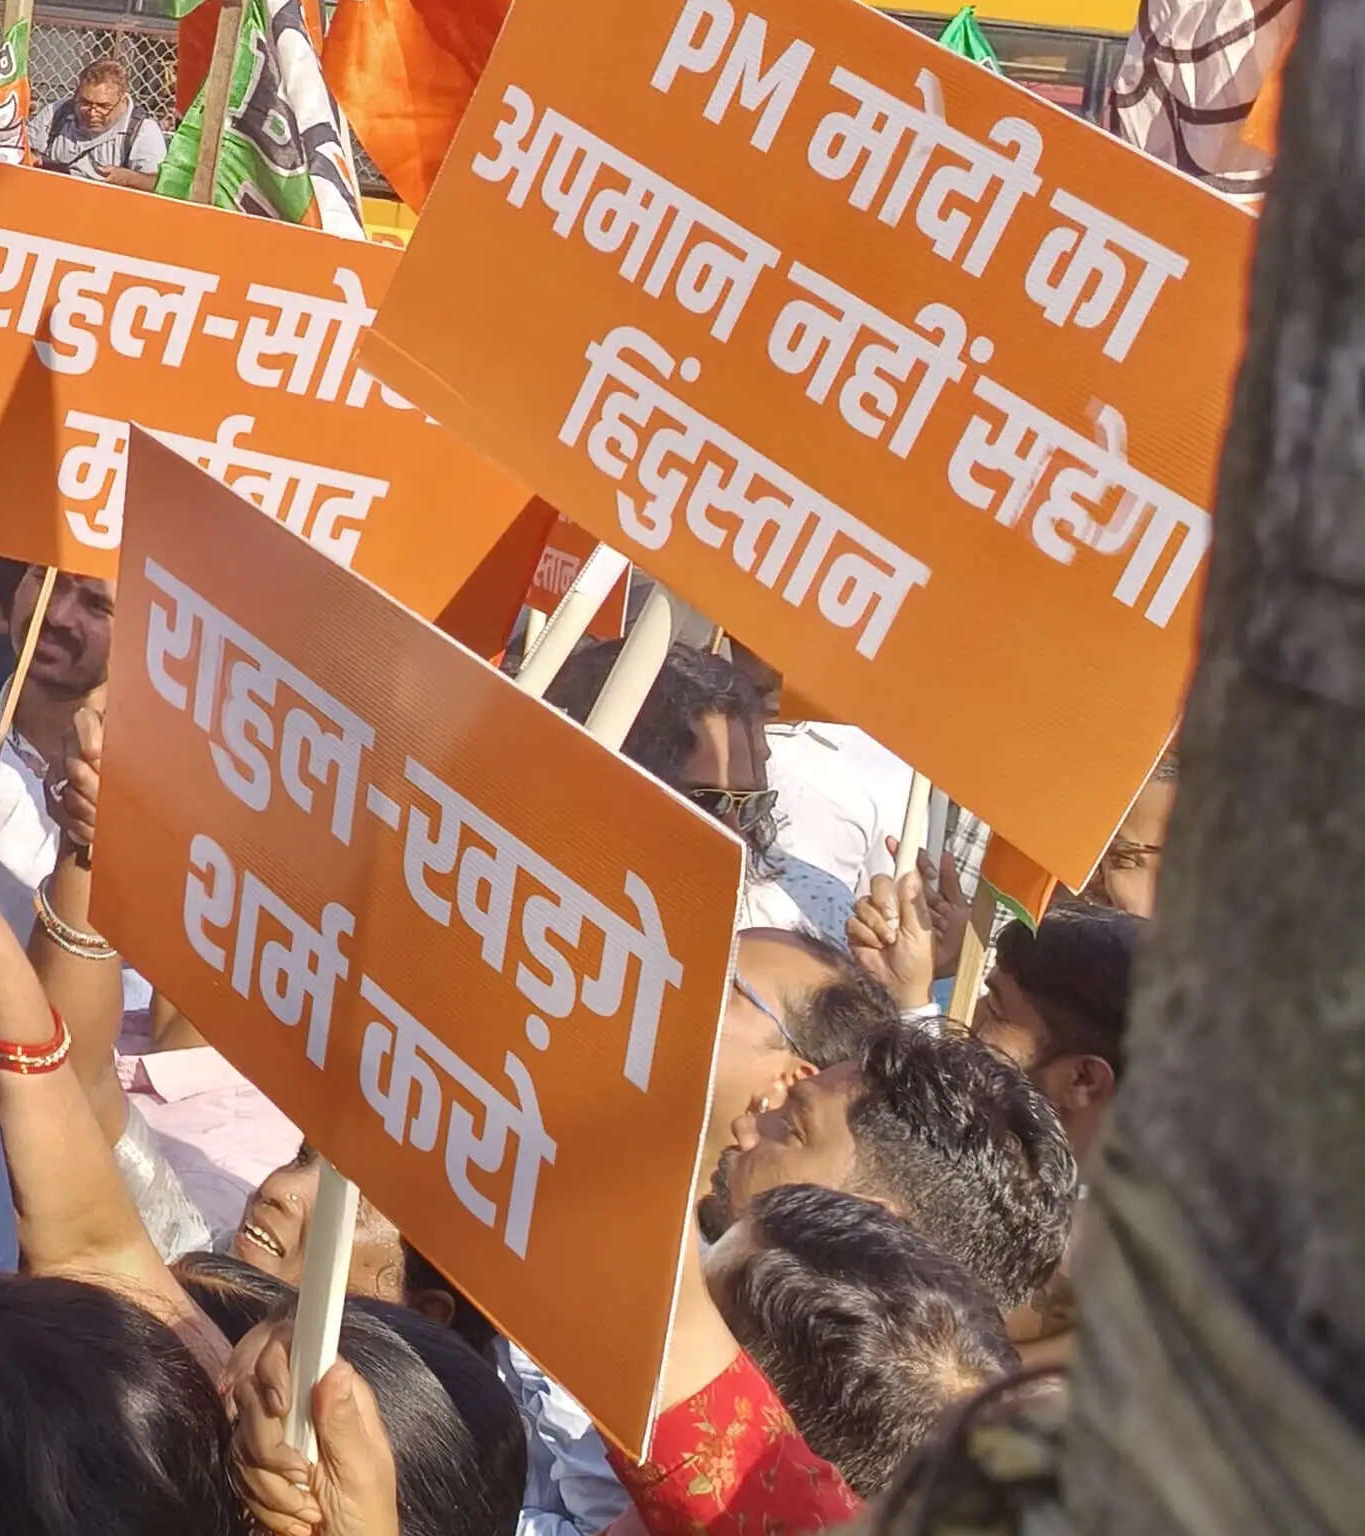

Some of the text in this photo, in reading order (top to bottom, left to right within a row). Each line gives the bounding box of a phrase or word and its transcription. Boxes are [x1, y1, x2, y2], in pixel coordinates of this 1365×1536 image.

[471, 84, 781, 344] अपमान
[768, 260, 995, 460] नहीं
[807, 67, 1043, 278] मोदी
[1024, 189, 1189, 364] का
[558, 324, 933, 661] हिंदुस्तान
[182, 833, 559, 1262] शर्म करो
